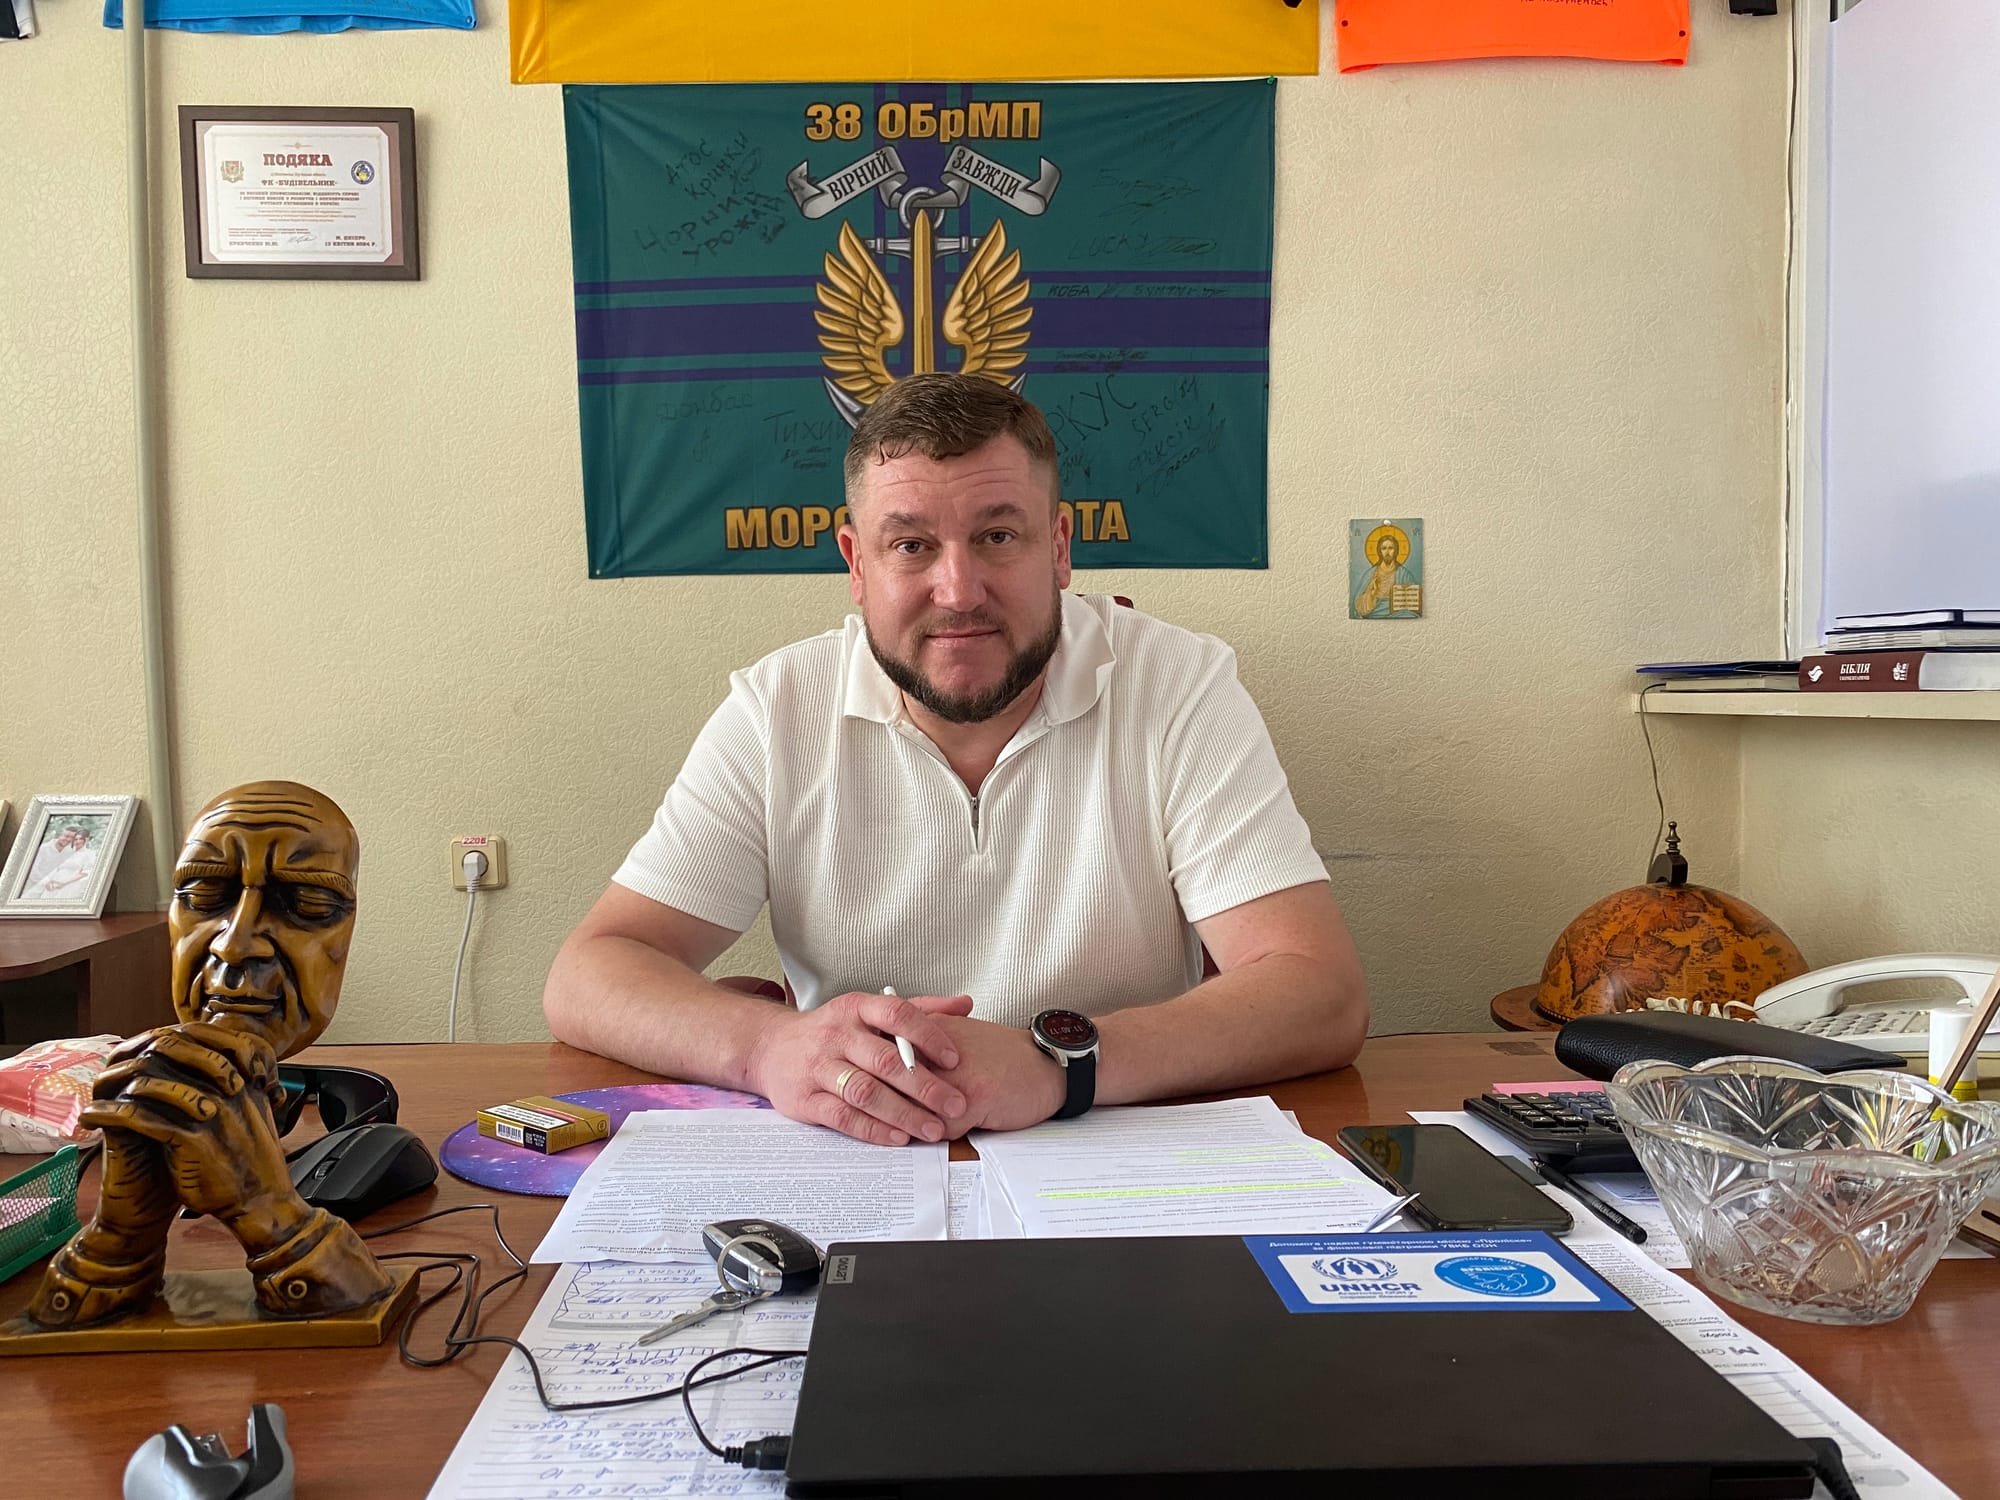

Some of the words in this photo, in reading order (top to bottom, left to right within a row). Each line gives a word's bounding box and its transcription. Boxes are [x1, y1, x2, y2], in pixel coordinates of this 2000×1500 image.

[805, 102, 862, 141] 38
[877, 101, 1042, 143] ОБрМП
[263, 153, 333, 169] ПОДЯКА
[826, 150, 894, 202] ВІРНИЙ
[951, 149, 1022, 199] ЗАВЖДИ
[1840, 663, 1871, 674] БІБЛІЯ
[832, 1257, 849, 1281] Lenovo
[1320, 1283, 1422, 1292] UNHCR
